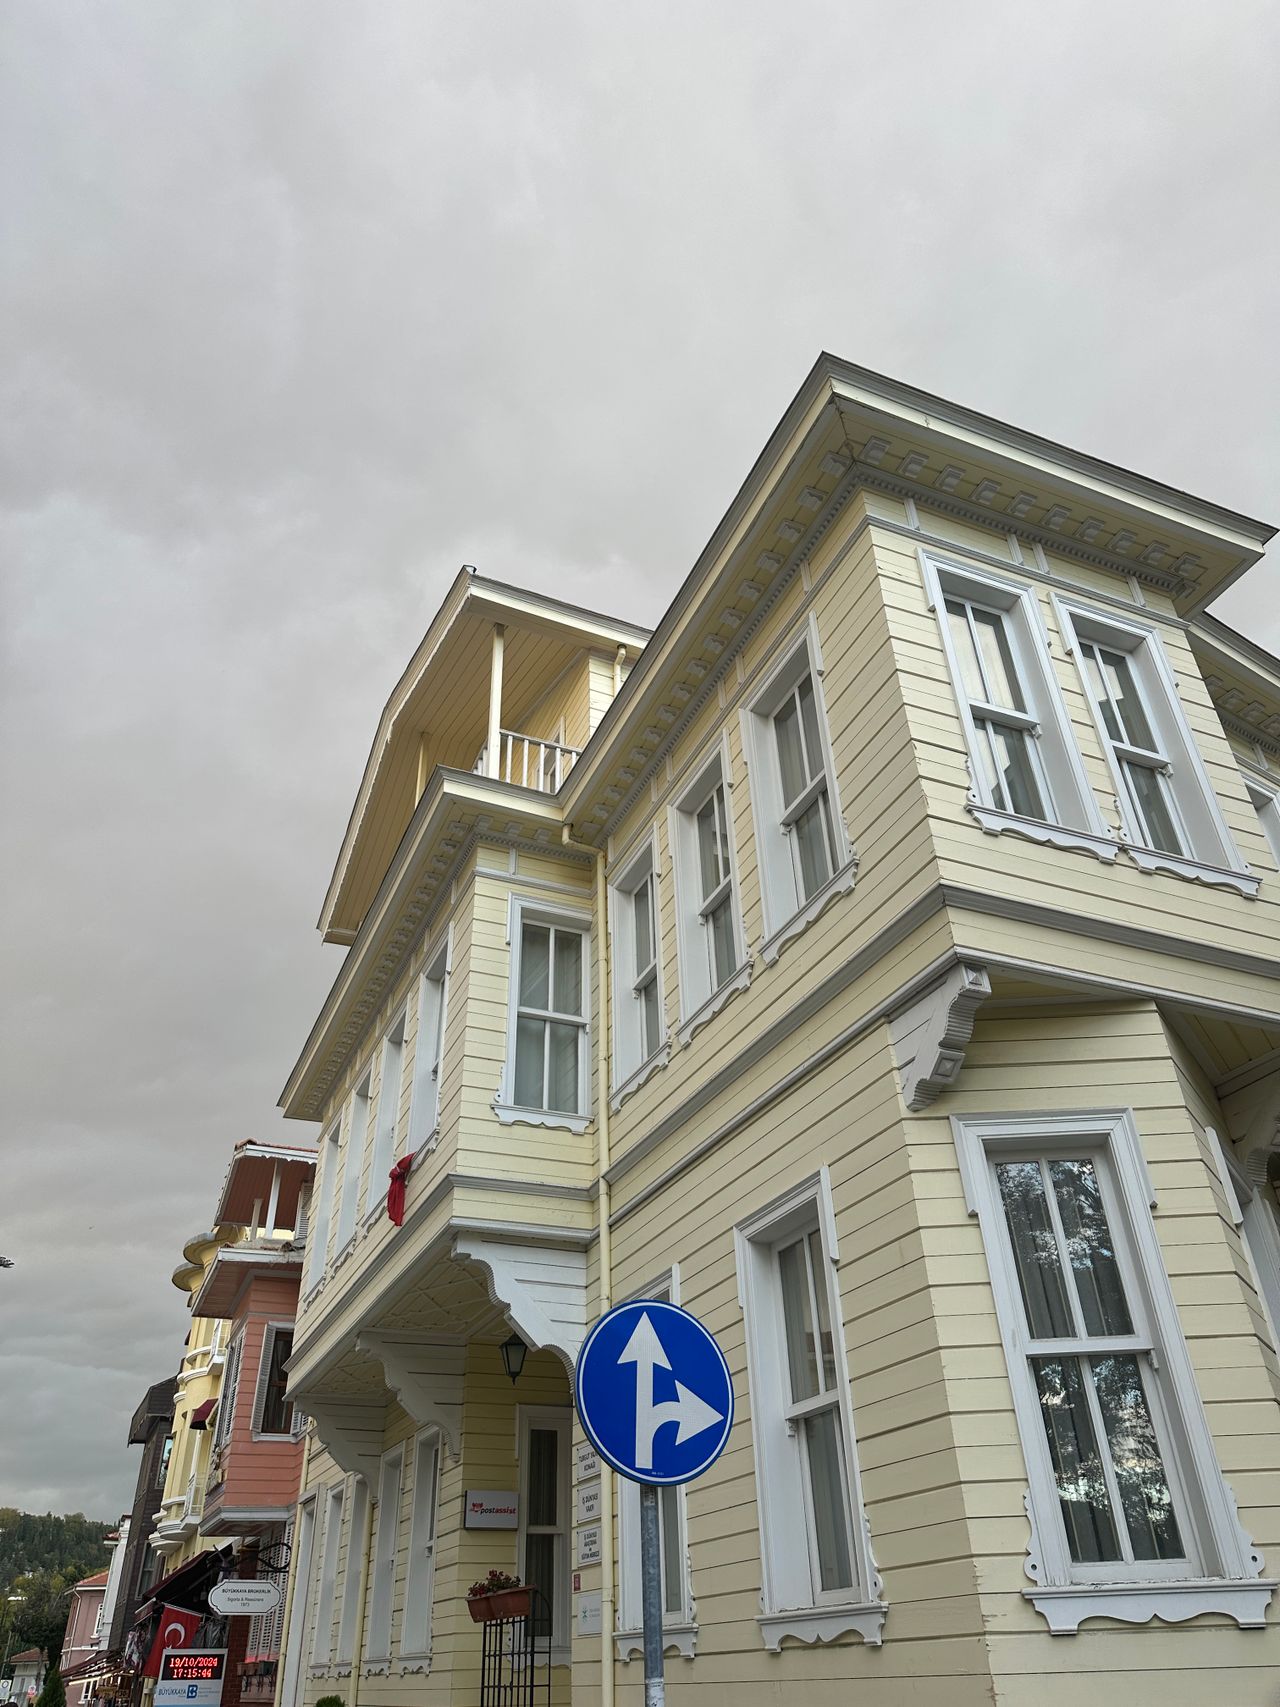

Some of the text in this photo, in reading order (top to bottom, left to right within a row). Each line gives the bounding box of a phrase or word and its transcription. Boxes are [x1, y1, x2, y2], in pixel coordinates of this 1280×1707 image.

[480, 1506, 517, 1515] postassist
[169, 1657, 218, 1667] 19/10/2024
[173, 1668, 212, 1678] 17:15:44
